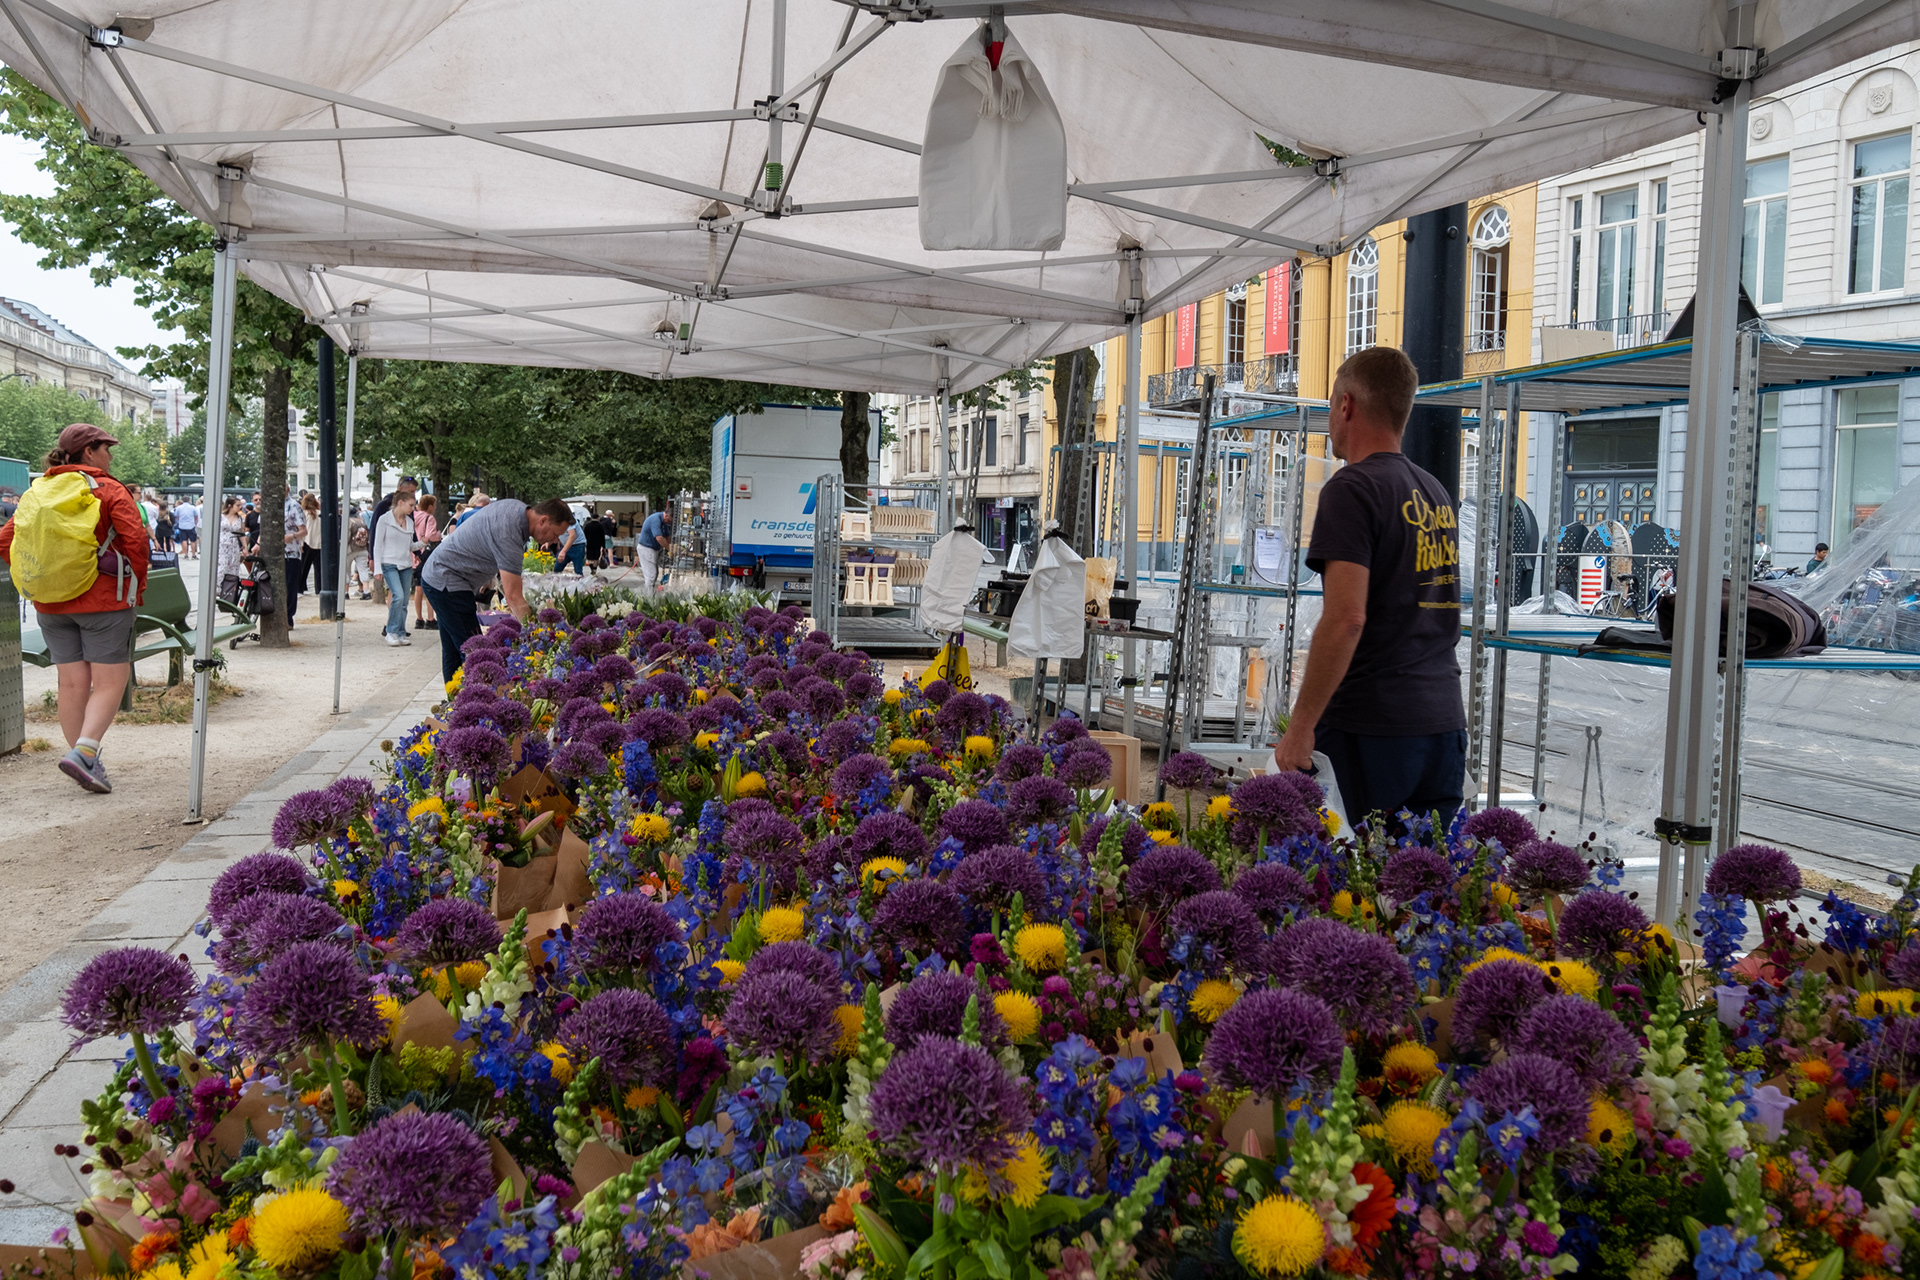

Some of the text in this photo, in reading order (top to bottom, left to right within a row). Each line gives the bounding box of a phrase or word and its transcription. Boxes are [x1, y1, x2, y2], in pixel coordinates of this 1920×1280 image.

[751, 519, 815, 532] transde
[783, 532, 813, 540] gehuurd,
[1415, 529, 1459, 572] house
